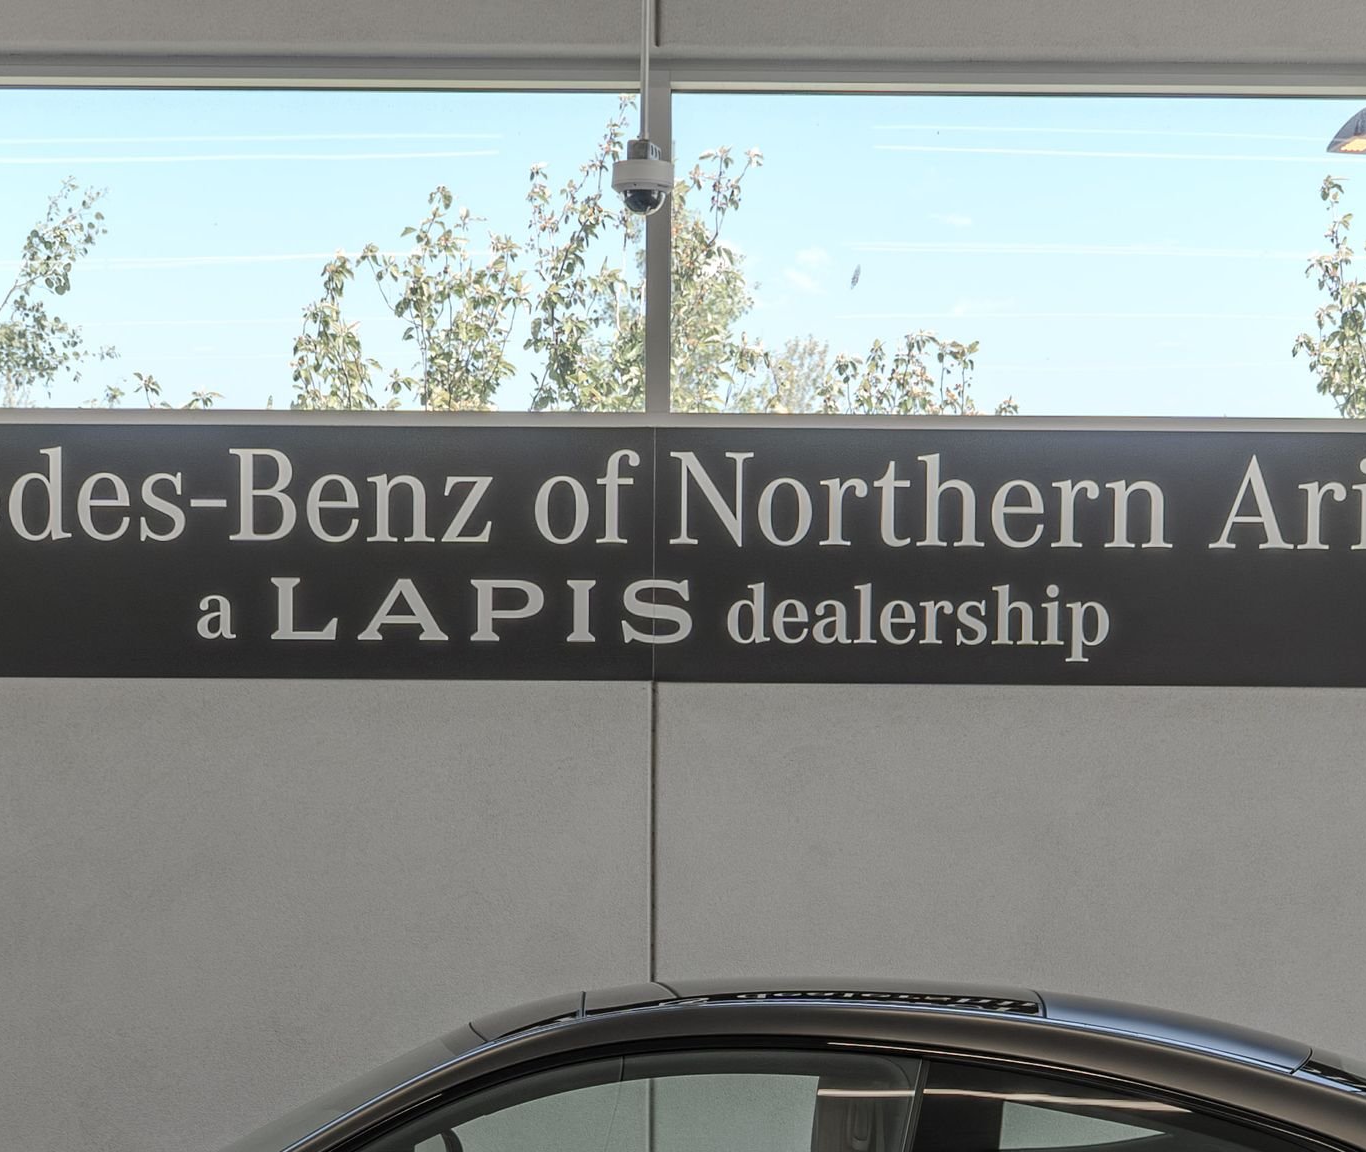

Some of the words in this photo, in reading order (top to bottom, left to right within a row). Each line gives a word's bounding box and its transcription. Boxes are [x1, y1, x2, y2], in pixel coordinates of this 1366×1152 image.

[534, 448, 641, 545] of
[669, 451, 1174, 549] Northern
[196, 594, 237, 641] a
[270, 577, 693, 644] LAPIS
[727, 581, 1110, 663] dealership
